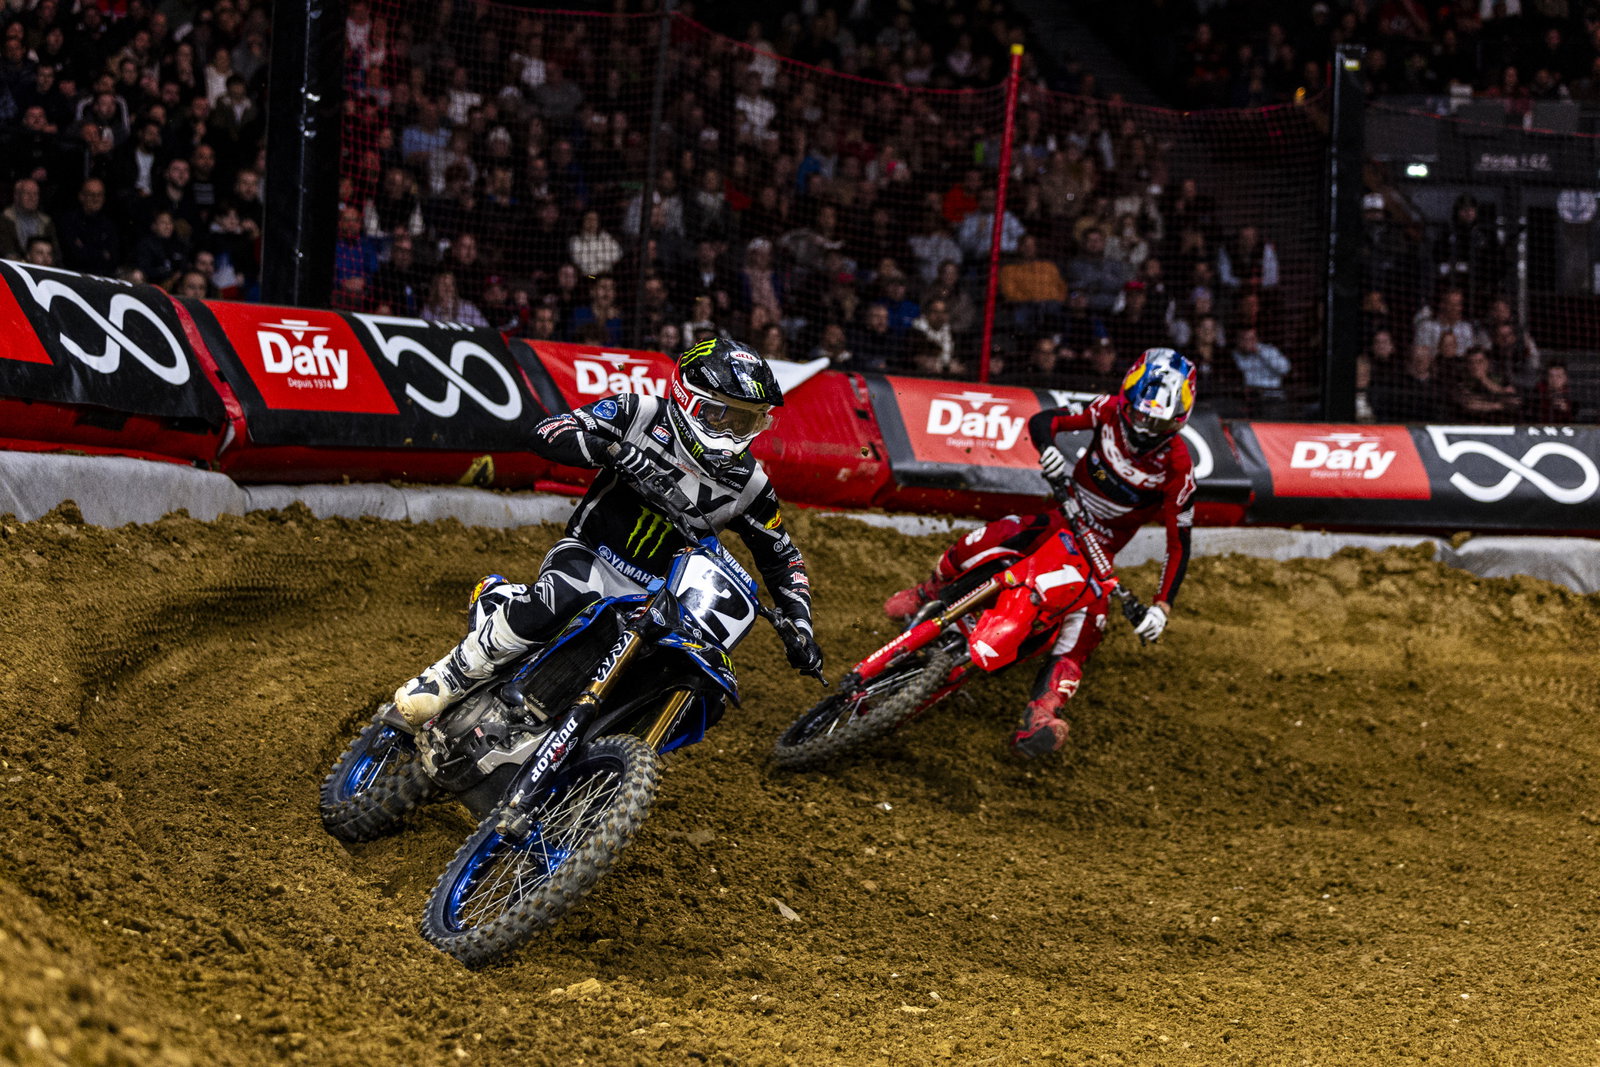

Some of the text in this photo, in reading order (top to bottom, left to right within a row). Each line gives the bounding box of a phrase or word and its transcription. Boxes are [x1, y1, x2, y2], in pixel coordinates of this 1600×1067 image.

[257, 331, 348, 390] Dafy
[286, 376, 333, 390] Depuis 1974
[927, 399, 1025, 450] Dafy
[1290, 440, 1397, 479] Dafy
[611, 553, 653, 585] YAMAH
[531, 717, 578, 782] DUNLOP
